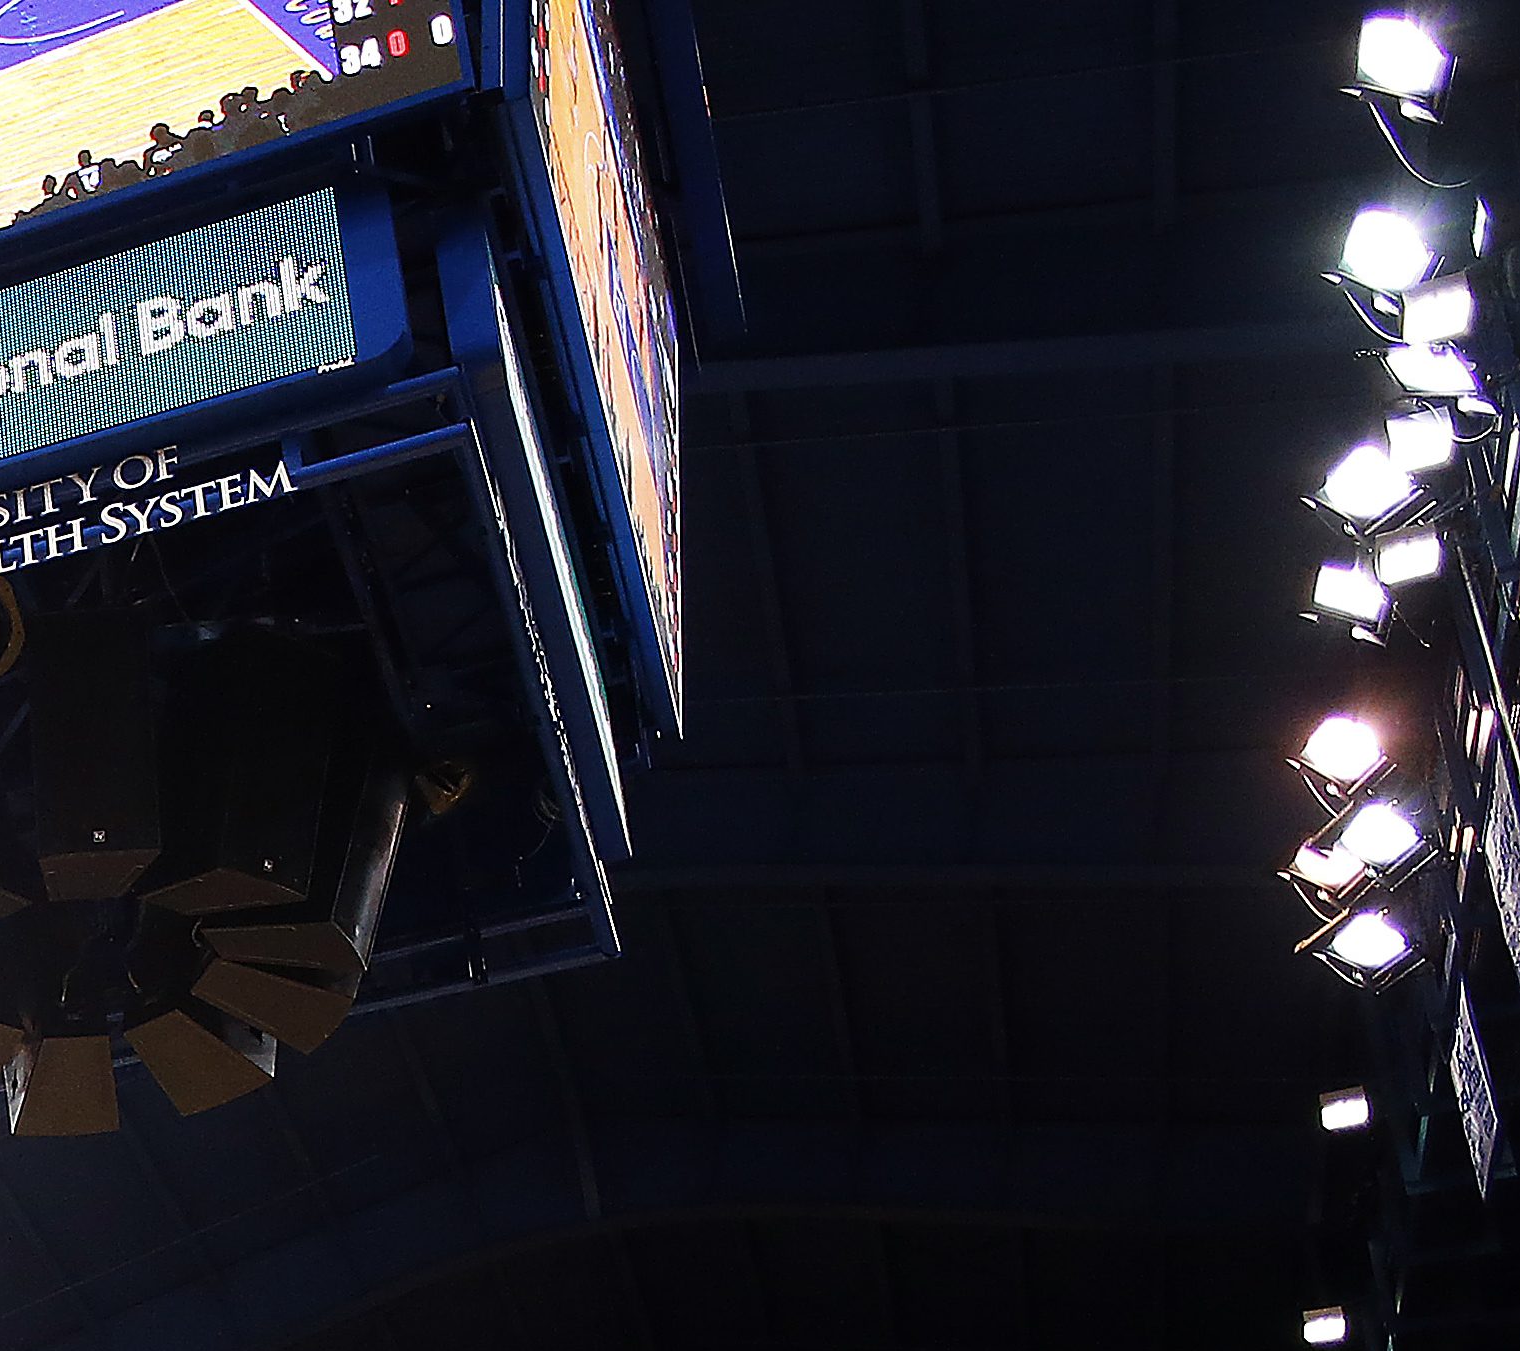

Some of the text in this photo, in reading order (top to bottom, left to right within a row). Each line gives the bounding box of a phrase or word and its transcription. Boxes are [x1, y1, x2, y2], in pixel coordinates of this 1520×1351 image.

[341, 36, 383, 76] 34
[429, 12, 456, 46] 0
[134, 256, 332, 356] Bank
[100, 460, 299, 544] SYSTEM
[112, 444, 179, 490] OF
